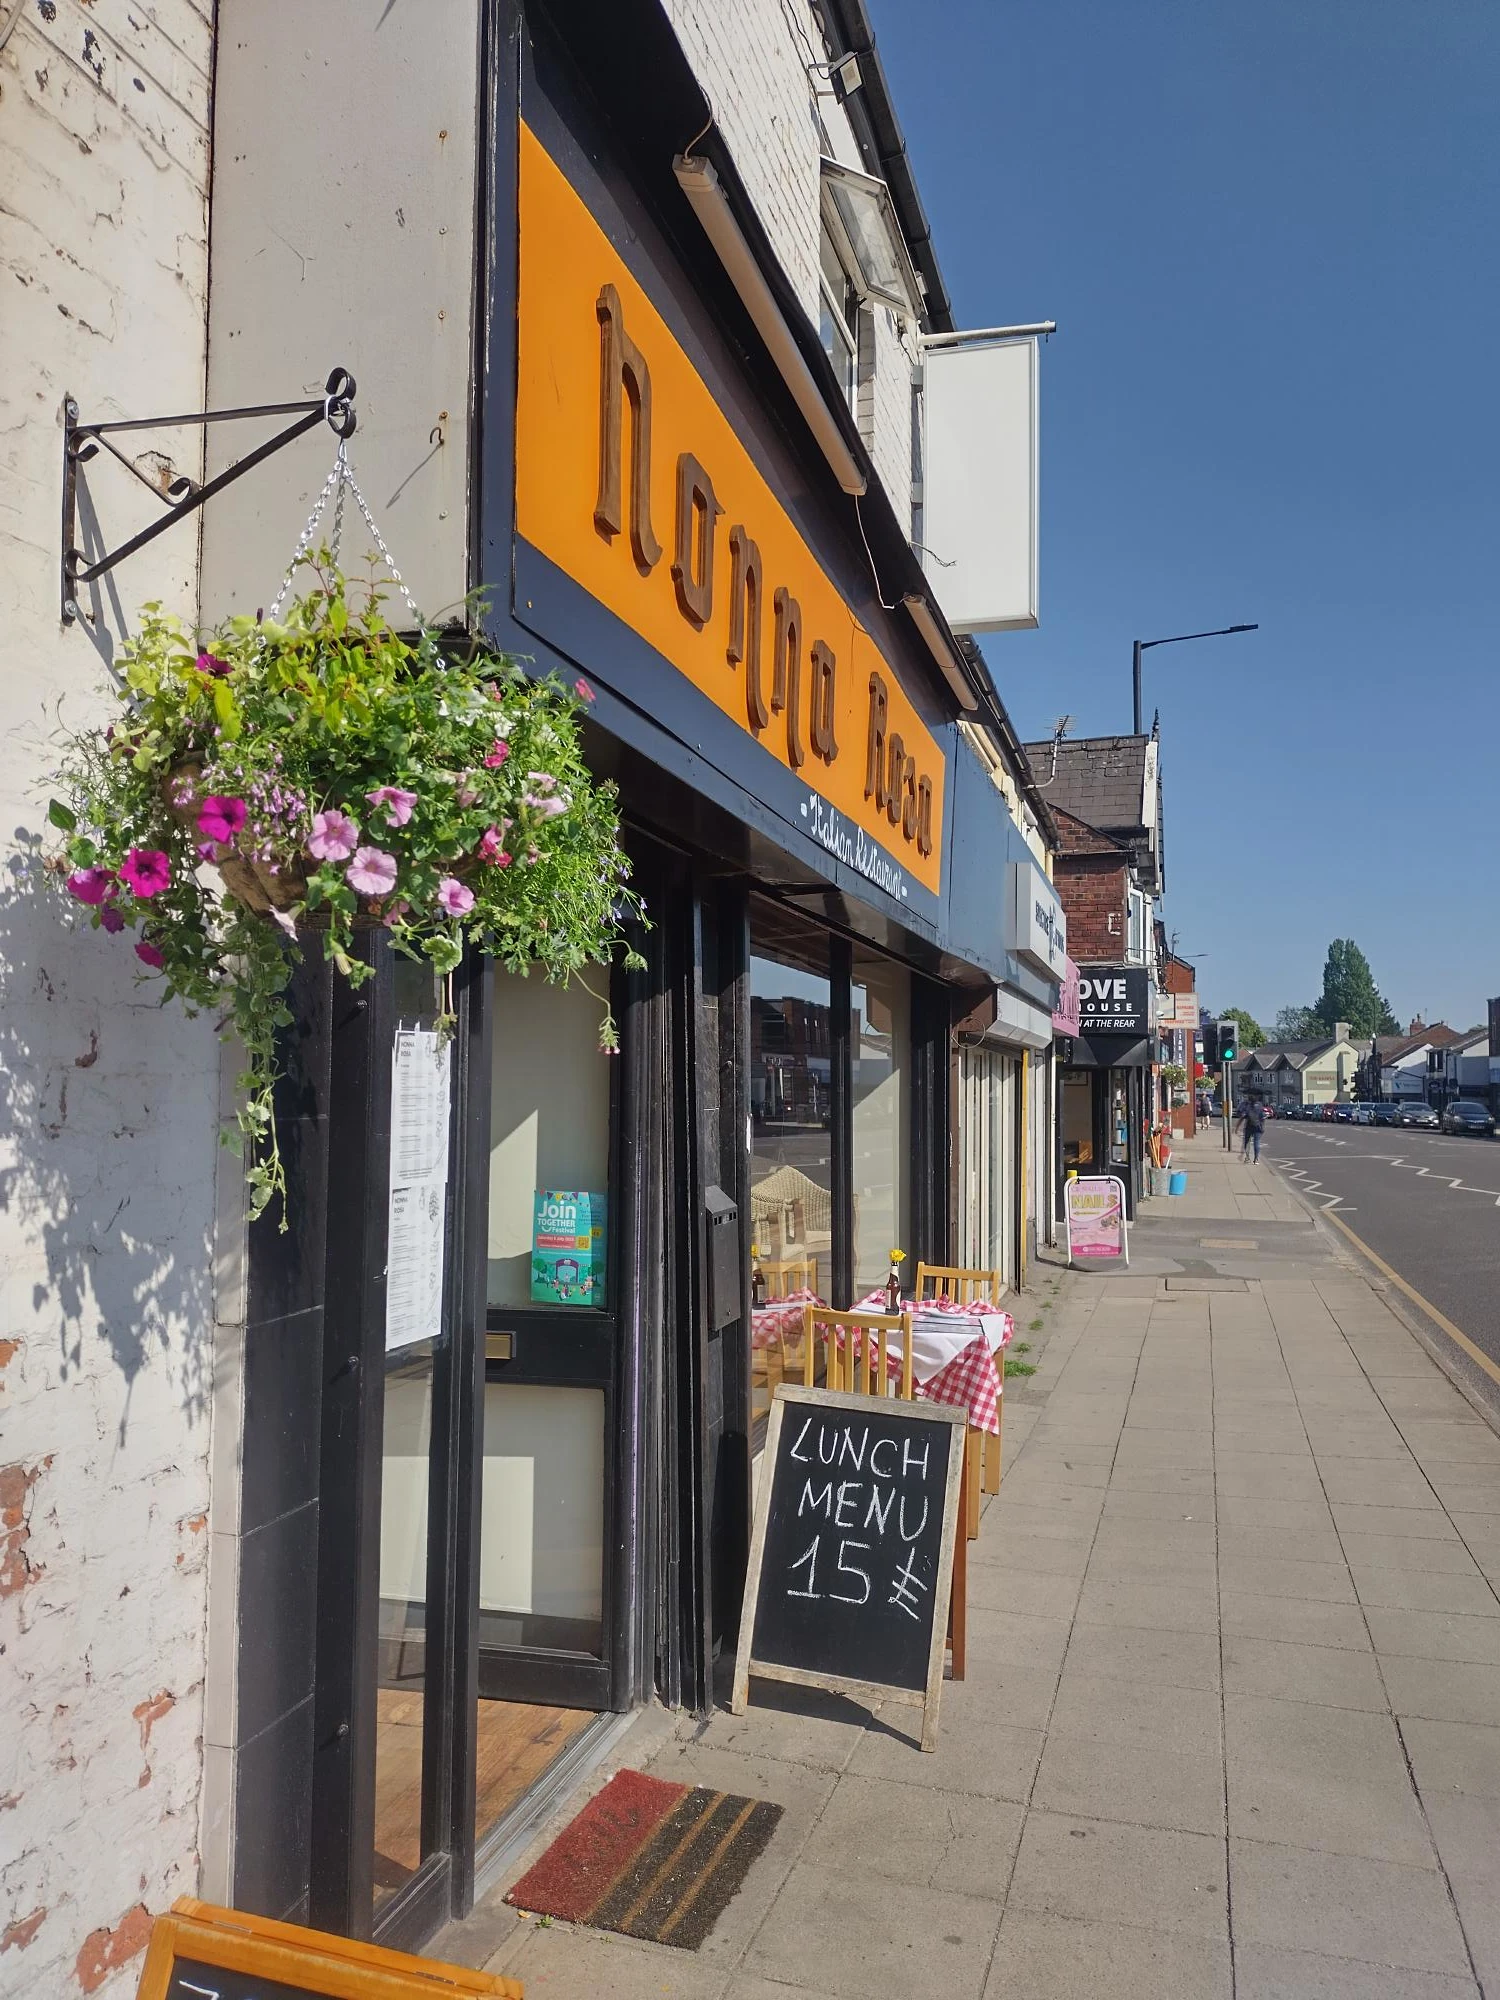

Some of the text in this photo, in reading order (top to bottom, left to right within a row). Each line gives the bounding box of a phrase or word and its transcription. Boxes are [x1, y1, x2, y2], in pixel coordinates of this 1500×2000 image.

[864, 671, 932, 858] Rosa
[809, 793, 902, 900] Italian Restaurant
[1079, 979, 1127, 1000] OVE
[1083, 1019, 1096, 1028] AT
[1096, 1019, 1113, 1028] THE
[1113, 1019, 1136, 1028] REAR
[537, 1200, 576, 1219] Join
[537, 1218, 576, 1228] TOGETHER
[551, 1226, 576, 1234] Festival
[789, 1416, 931, 1481] LUNCH
[797, 1477, 930, 1542] MENU
